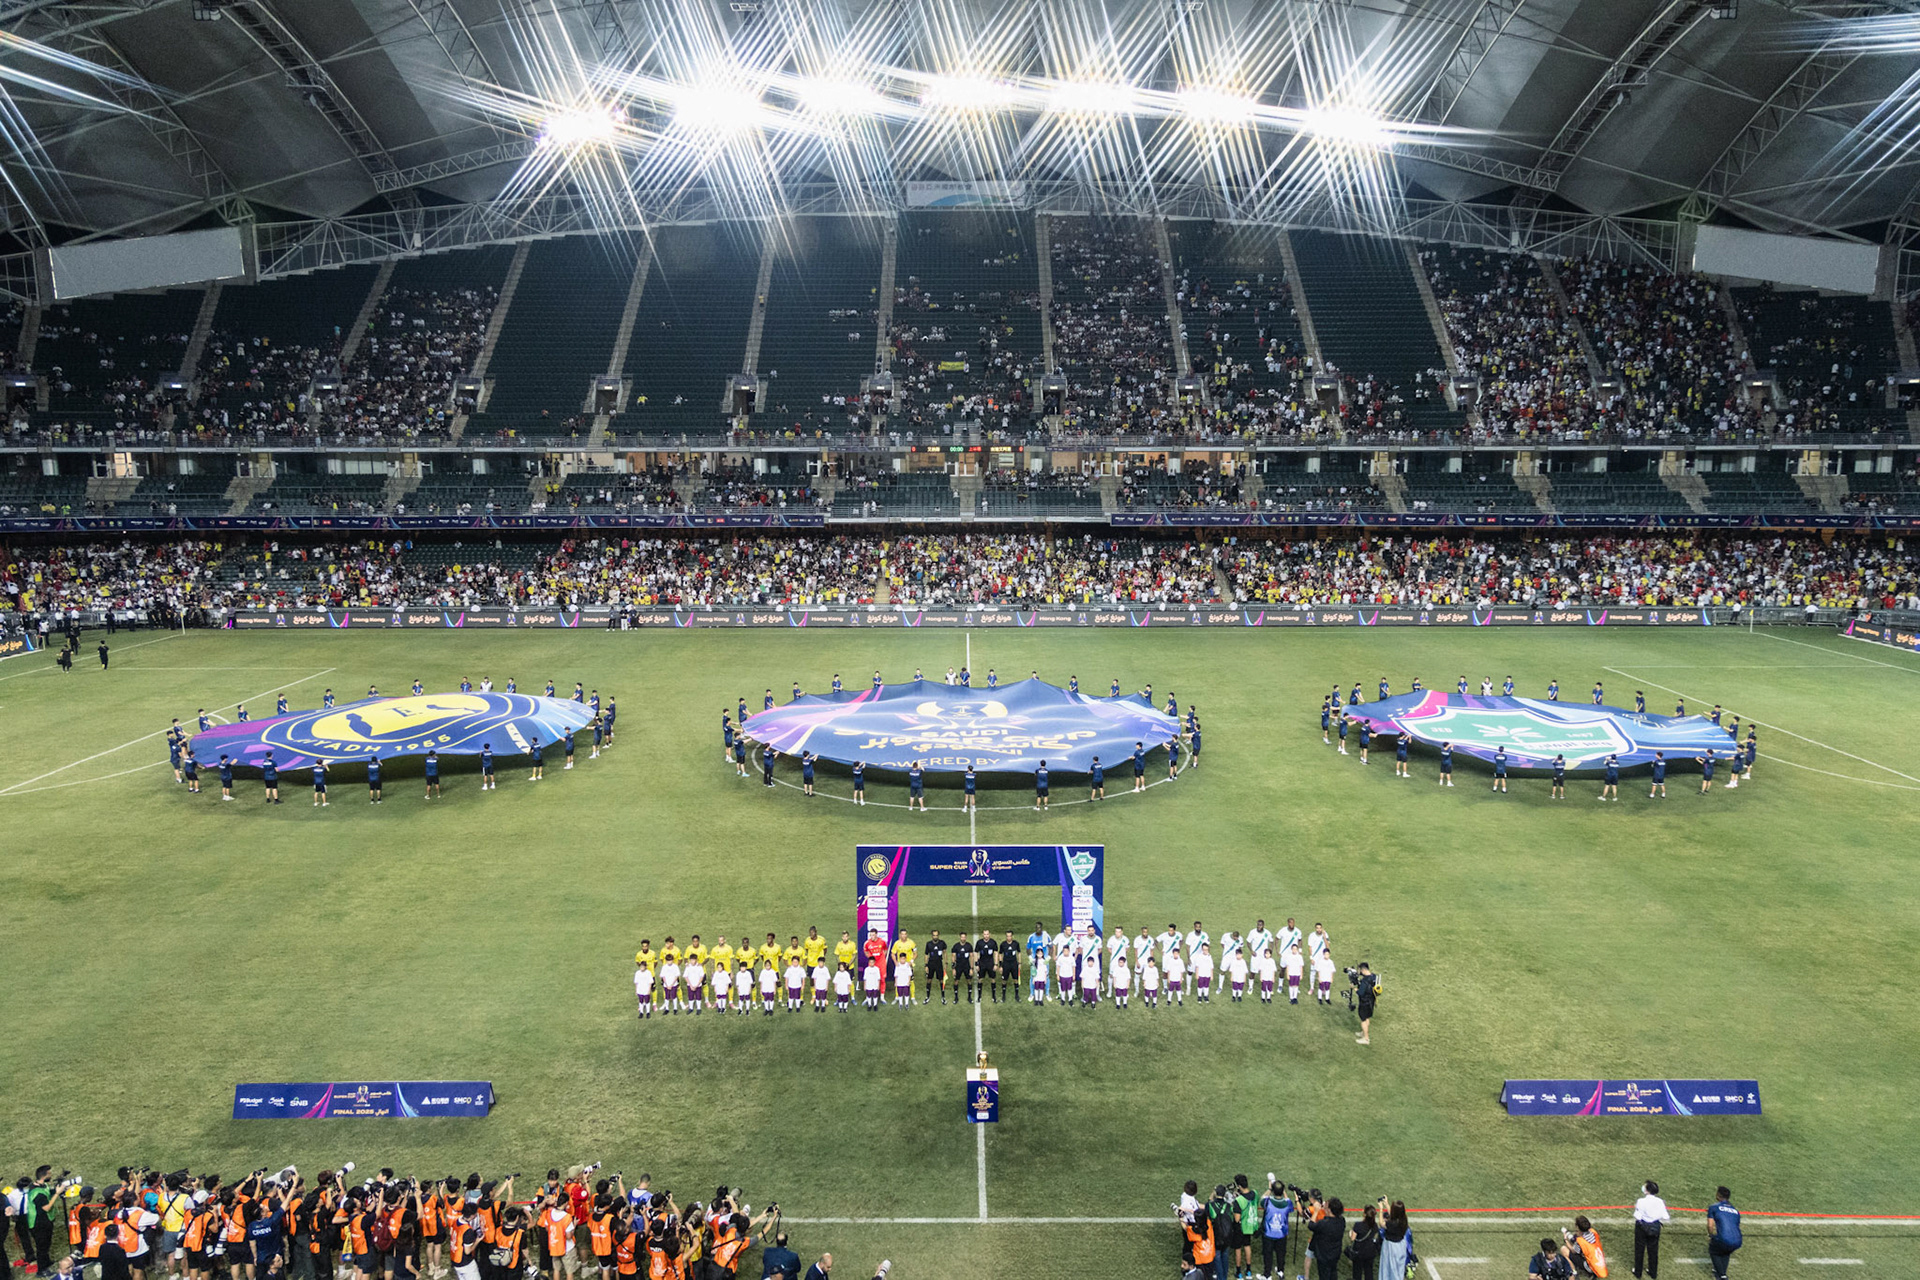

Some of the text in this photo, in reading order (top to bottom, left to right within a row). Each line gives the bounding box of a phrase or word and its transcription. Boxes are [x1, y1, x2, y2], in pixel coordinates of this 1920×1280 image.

[921, 729, 1008, 737] SAUDI
[394, 734, 452, 751] 1955
[1718, 1206, 1739, 1215] CREW
[252, 1227, 272, 1236] CREW
